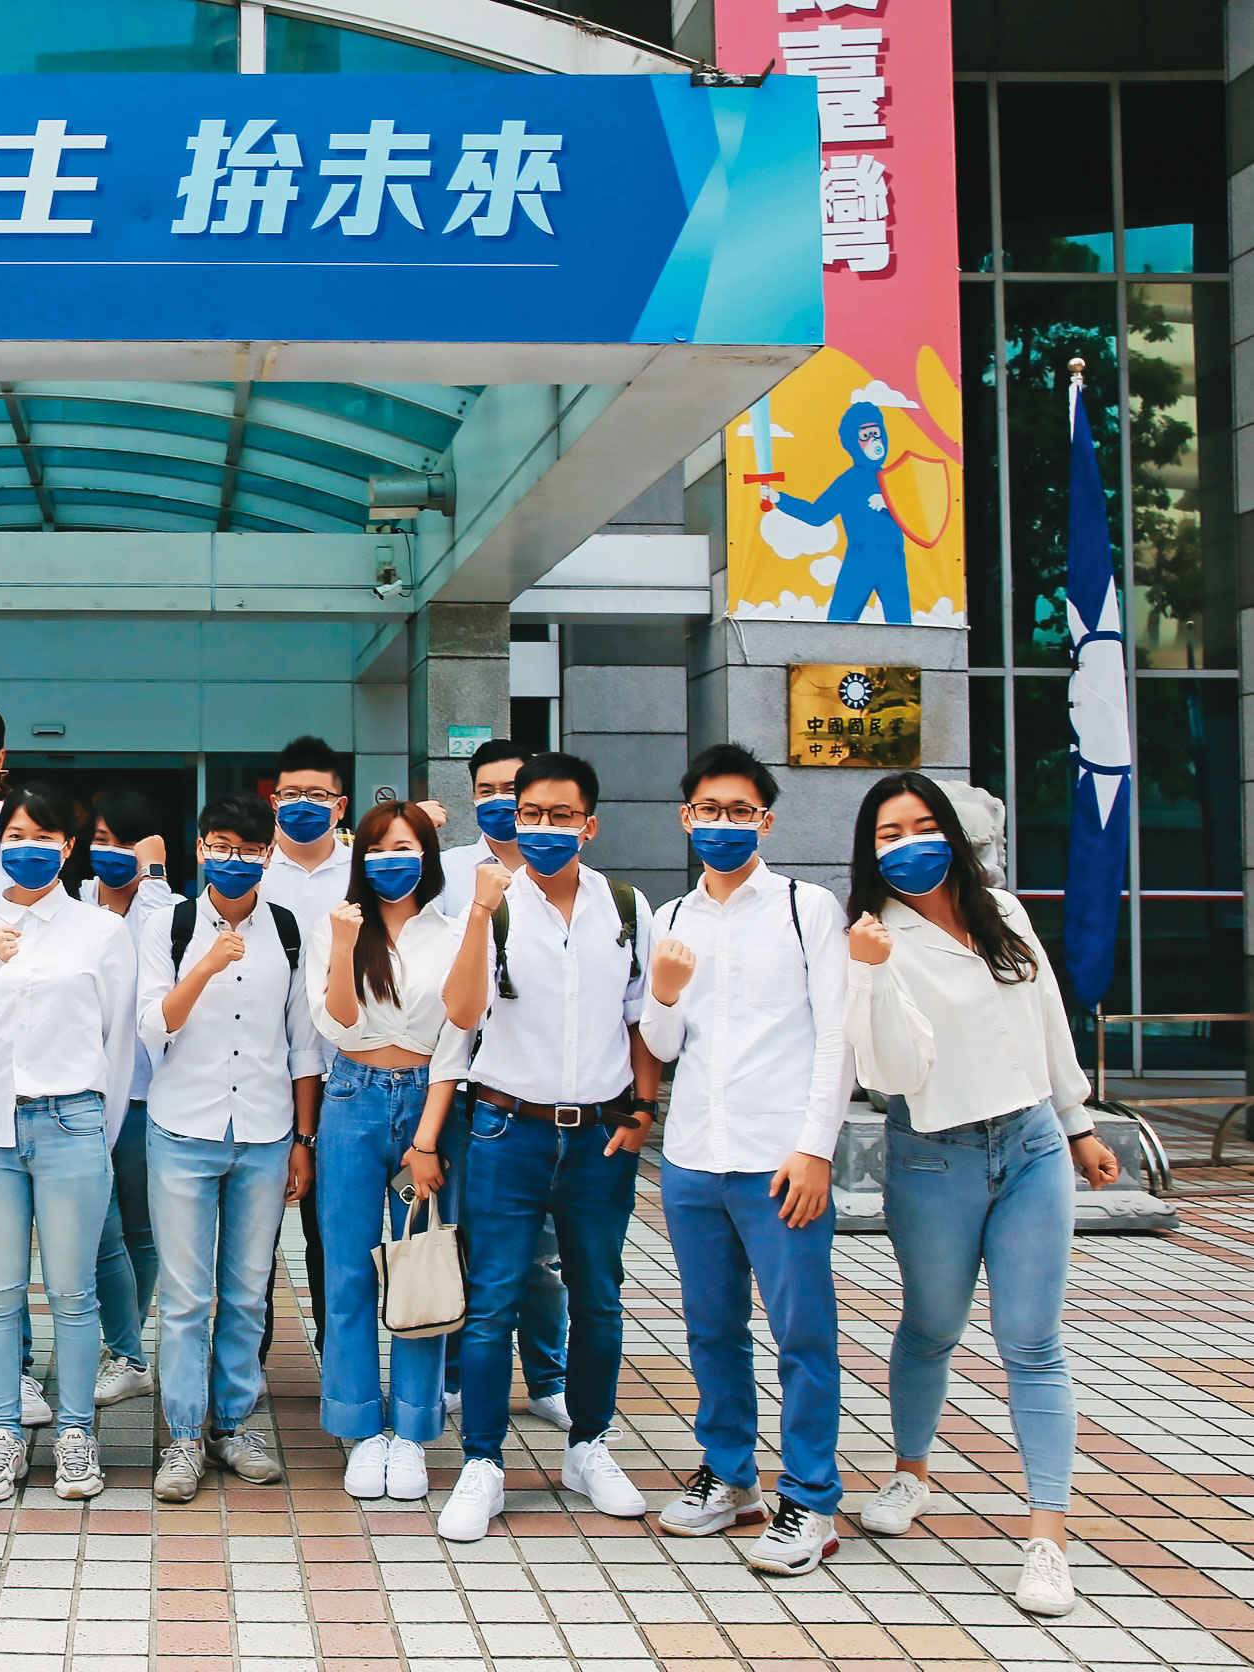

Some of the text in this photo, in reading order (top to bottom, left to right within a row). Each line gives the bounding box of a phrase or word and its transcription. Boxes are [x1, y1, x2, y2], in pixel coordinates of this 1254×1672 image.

[170, 119, 563, 236] 拚未來
[777, 0, 890, 272] 臺灣
[807, 716, 904, 737] 中國國民黨
